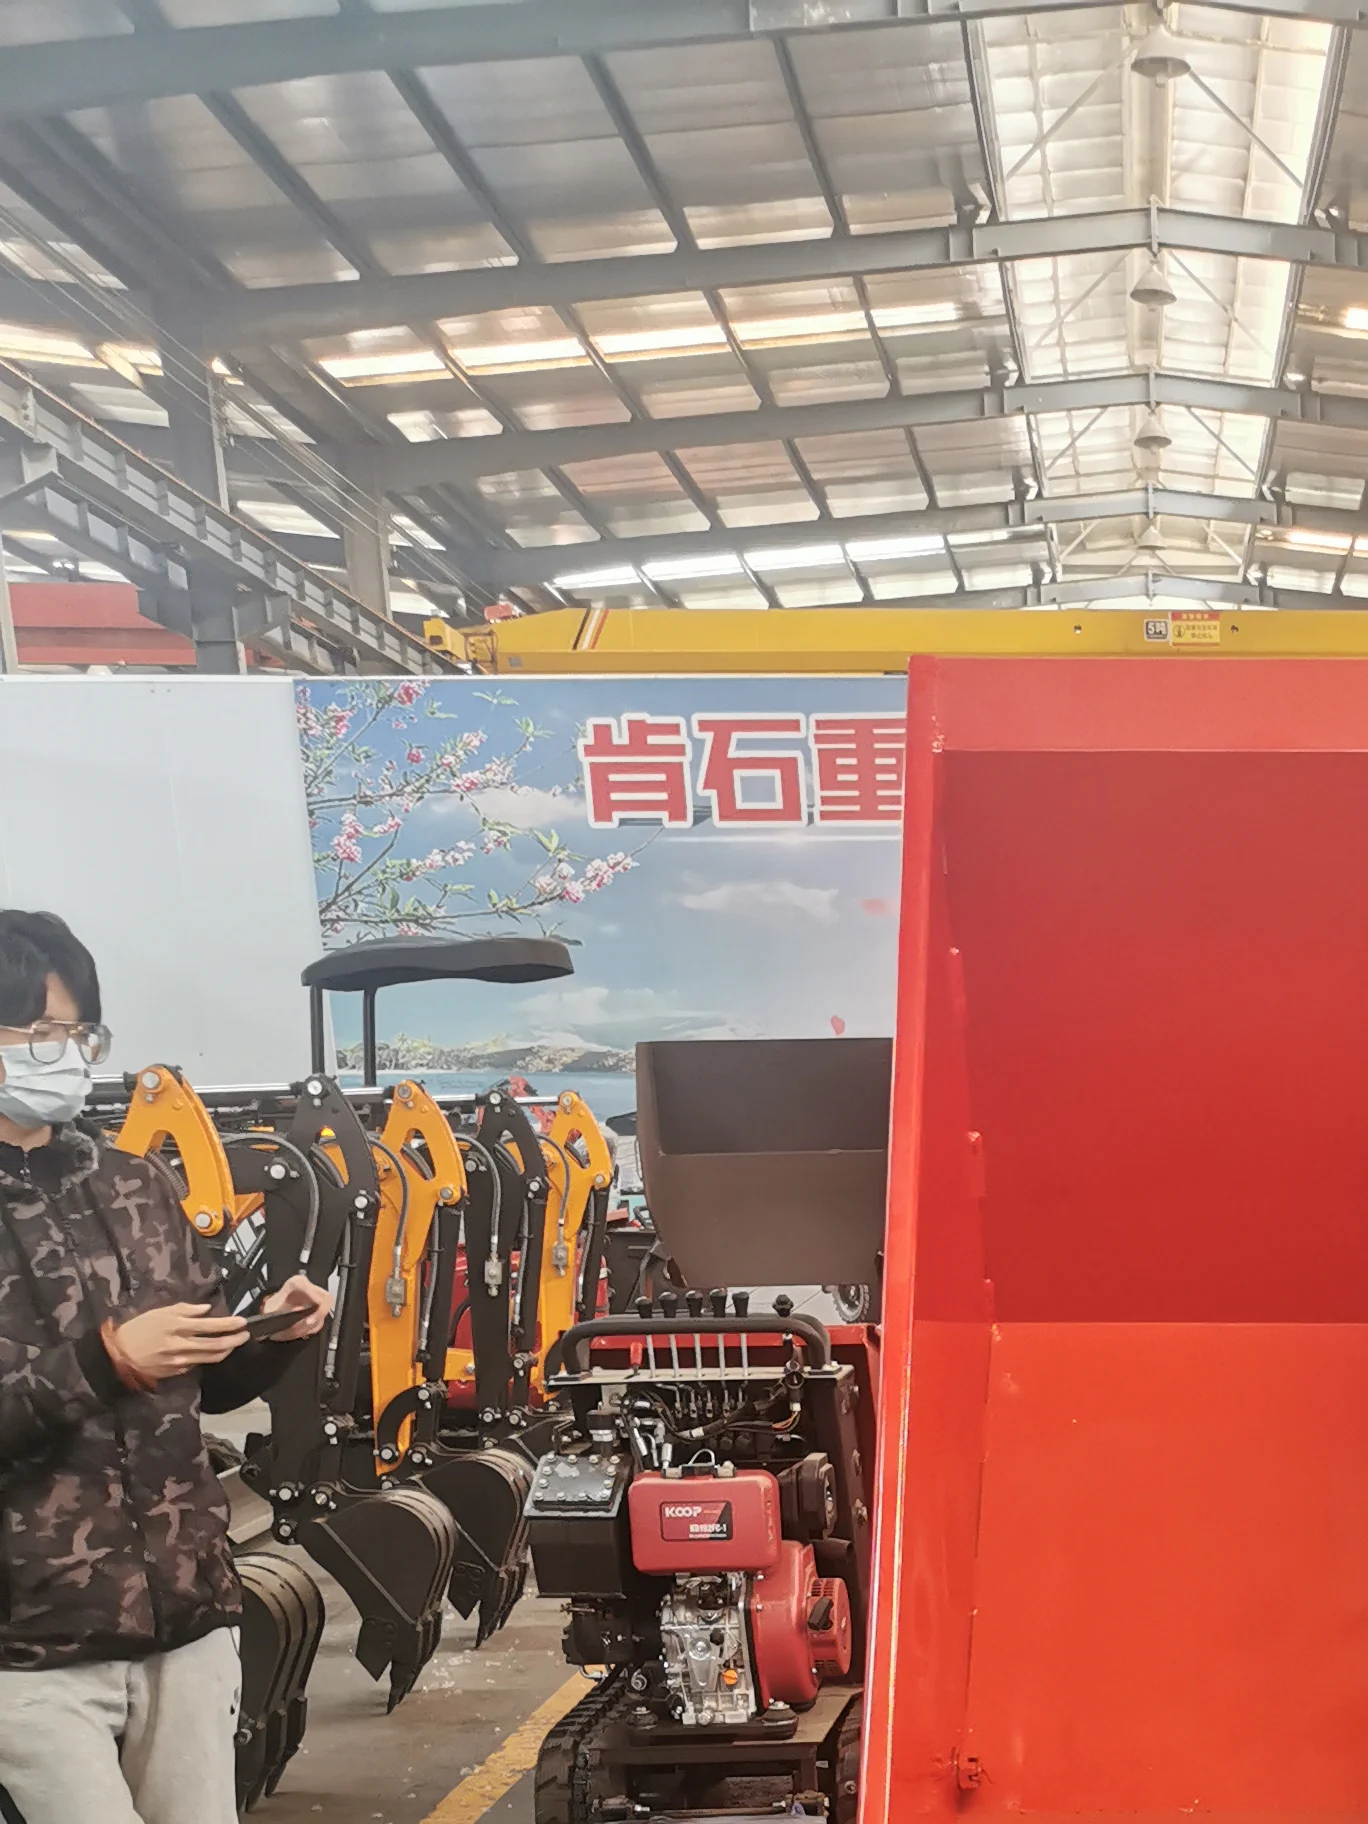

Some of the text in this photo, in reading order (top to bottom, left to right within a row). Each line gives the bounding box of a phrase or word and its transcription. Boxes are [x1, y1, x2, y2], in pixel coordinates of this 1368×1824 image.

[580, 715, 905, 826] 肯石重
[664, 1506, 702, 1518] KOOP
